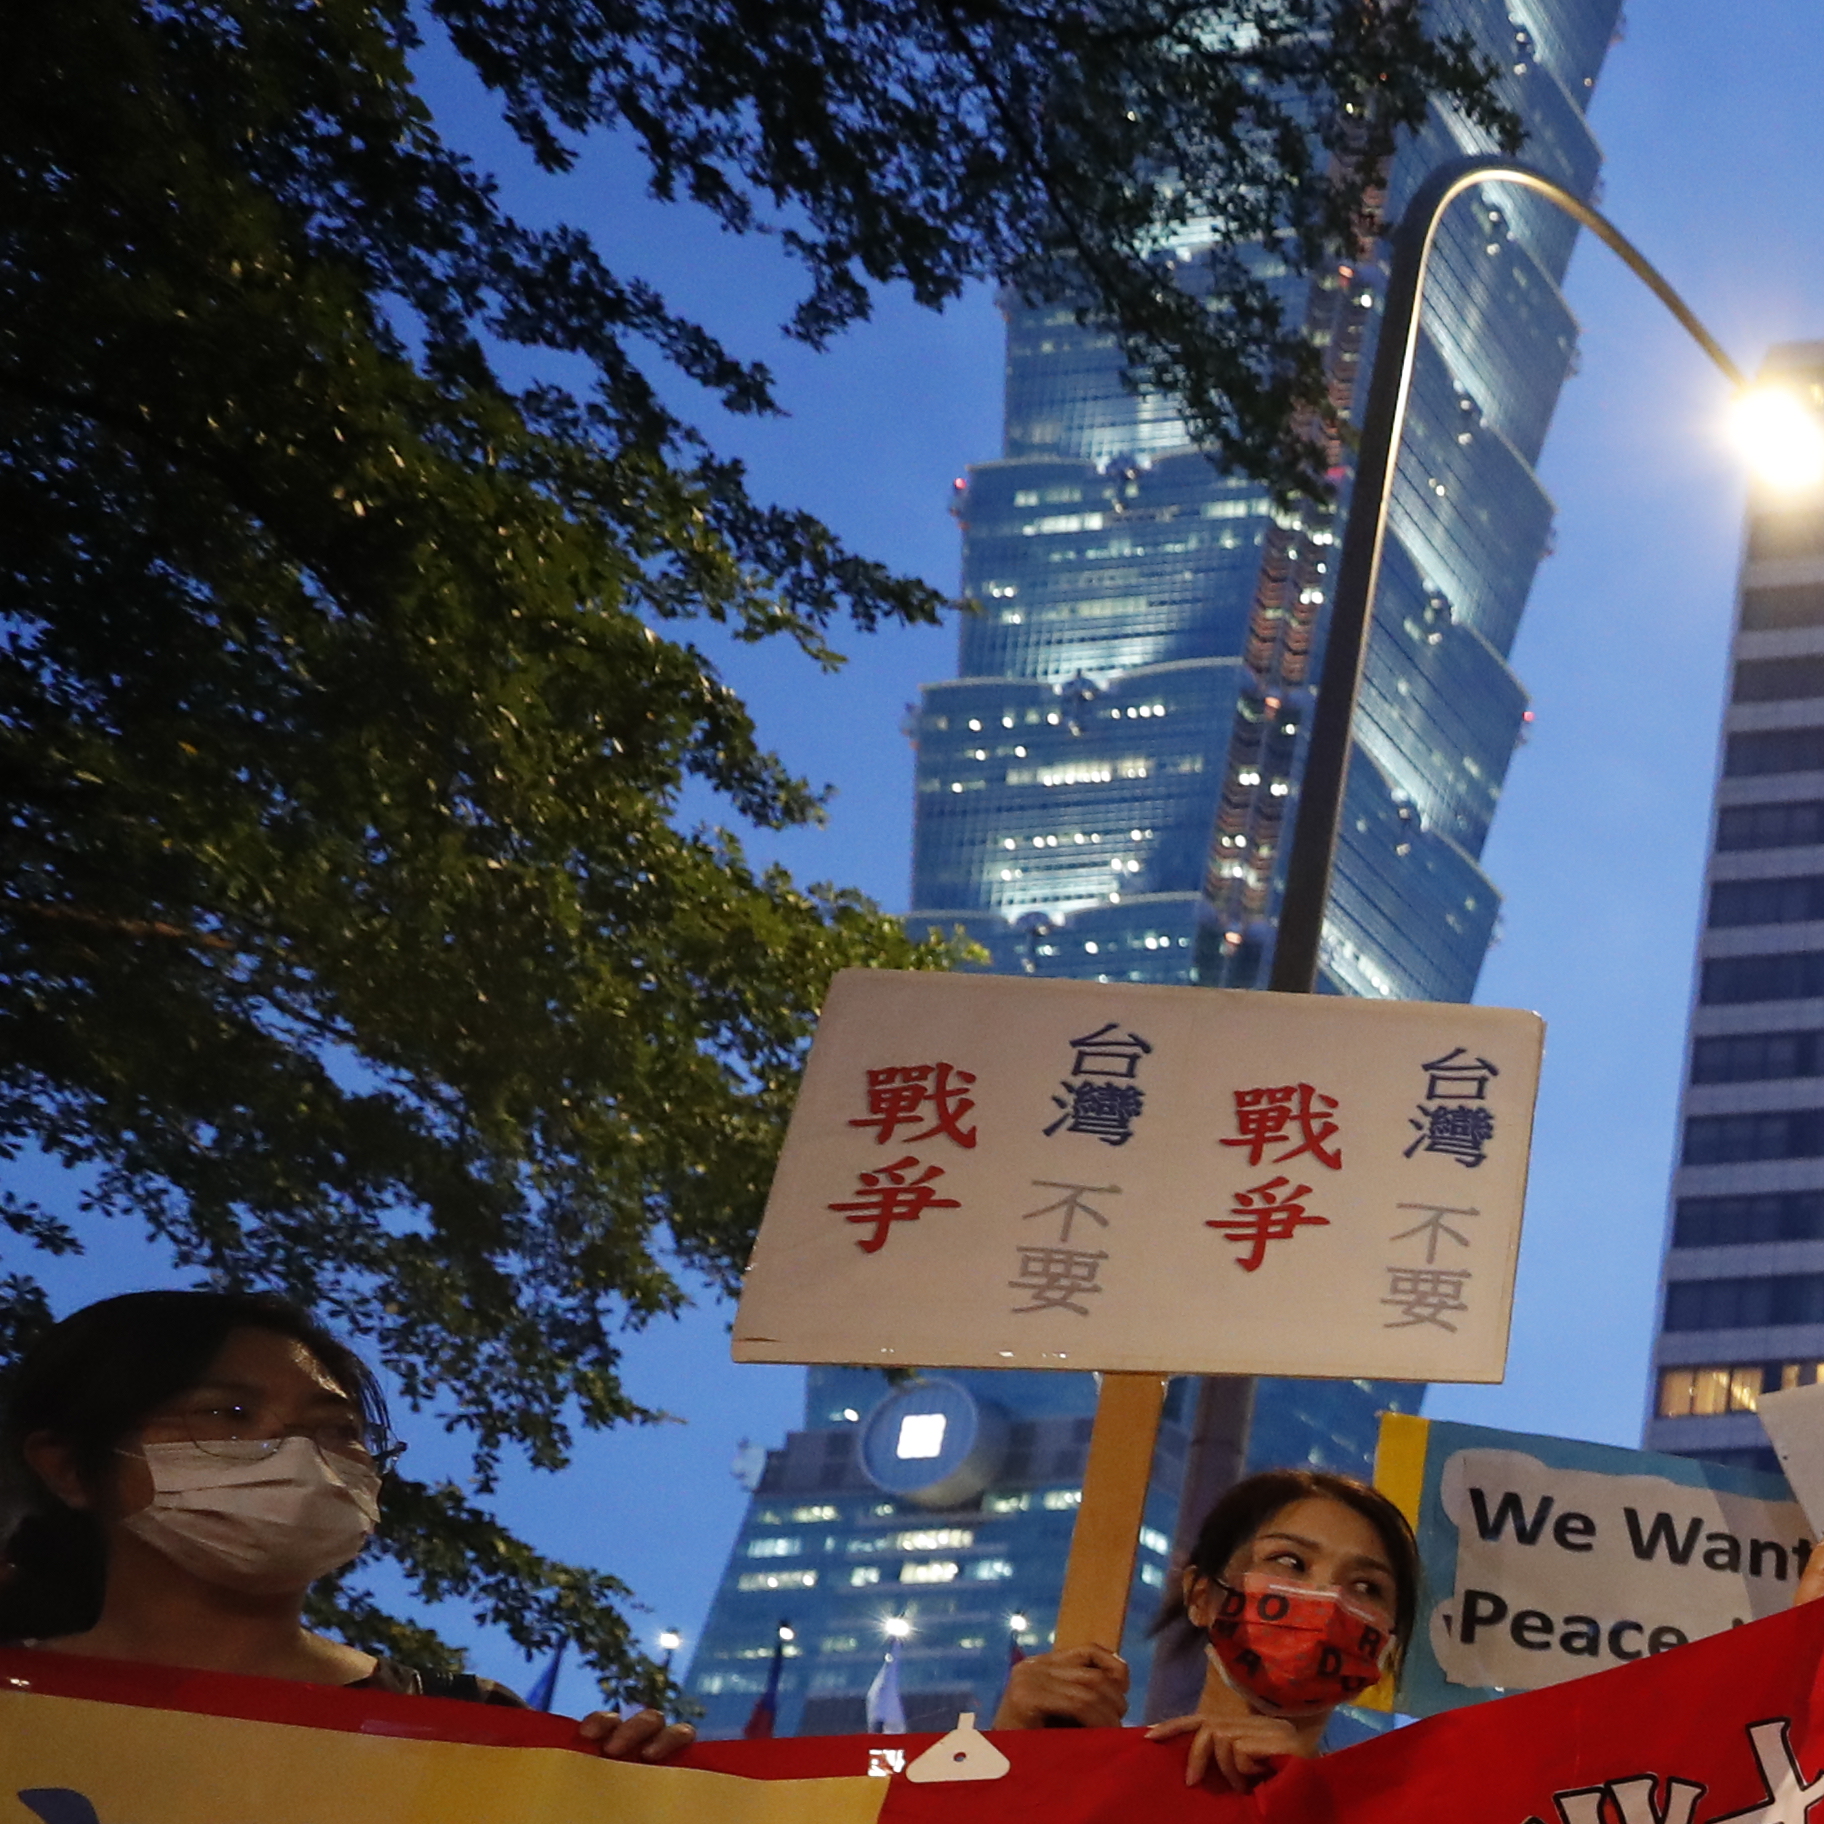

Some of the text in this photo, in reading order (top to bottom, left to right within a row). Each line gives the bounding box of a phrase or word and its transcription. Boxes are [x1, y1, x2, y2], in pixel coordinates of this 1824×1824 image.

[827, 1061, 977, 1254] 戰爭
[1206, 1083, 1344, 1273] 戰爭
[1470, 1487, 1597, 1552] We
[1459, 1590, 1689, 1661] Peace
